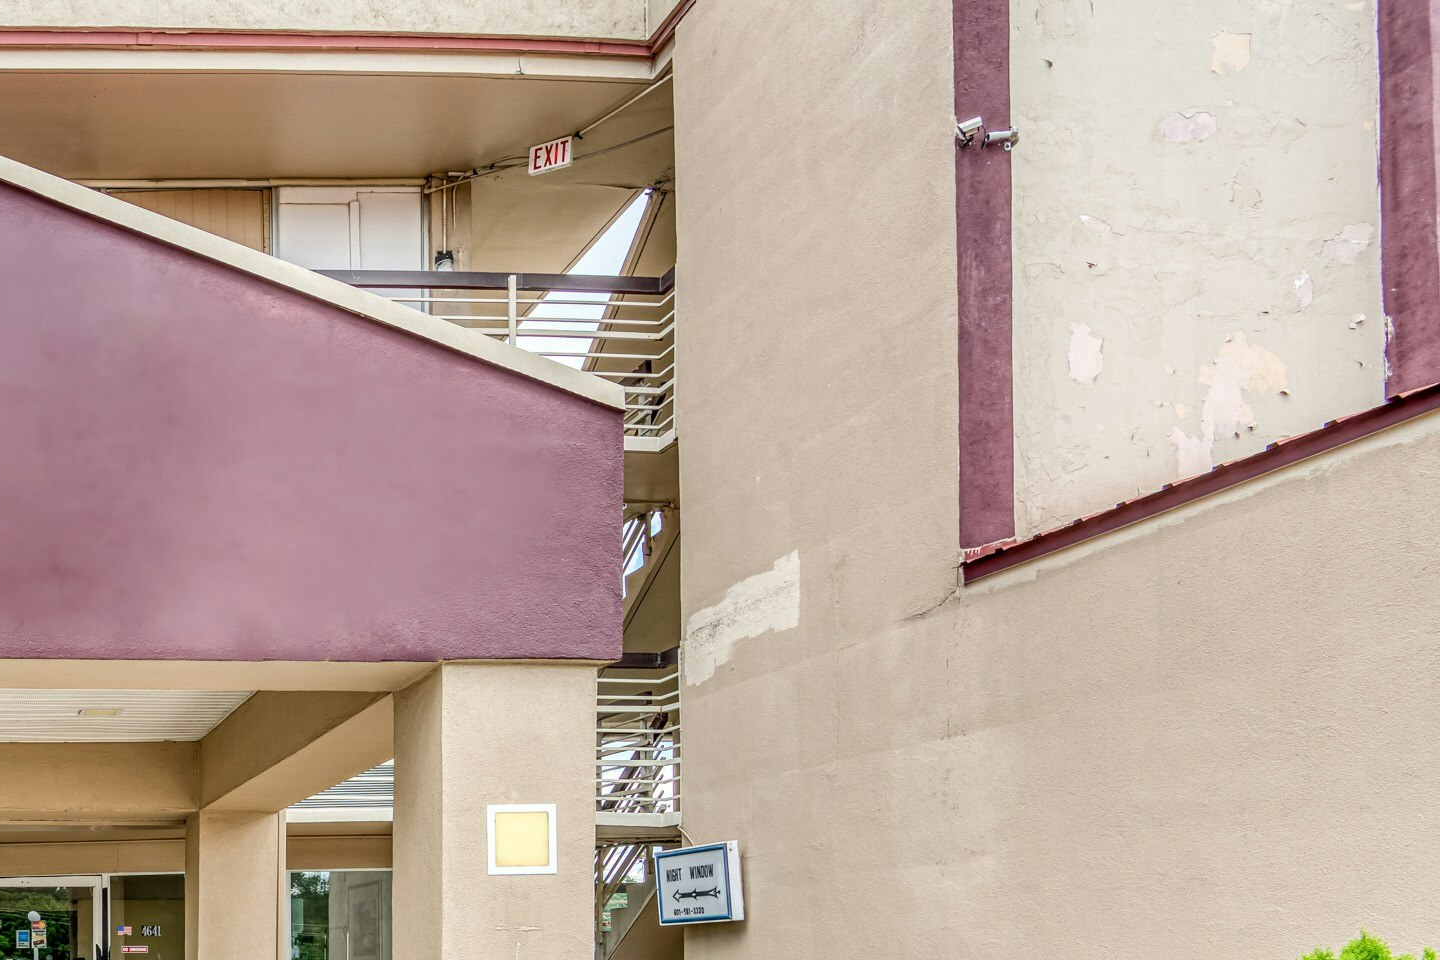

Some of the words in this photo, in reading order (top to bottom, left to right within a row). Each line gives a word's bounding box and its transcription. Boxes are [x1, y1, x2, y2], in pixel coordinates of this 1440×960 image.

[533, 139, 569, 170] EXIT
[665, 867, 682, 882] NIGHT
[688, 863, 714, 879] WINDOW
[141, 925, 162, 937] 4641
